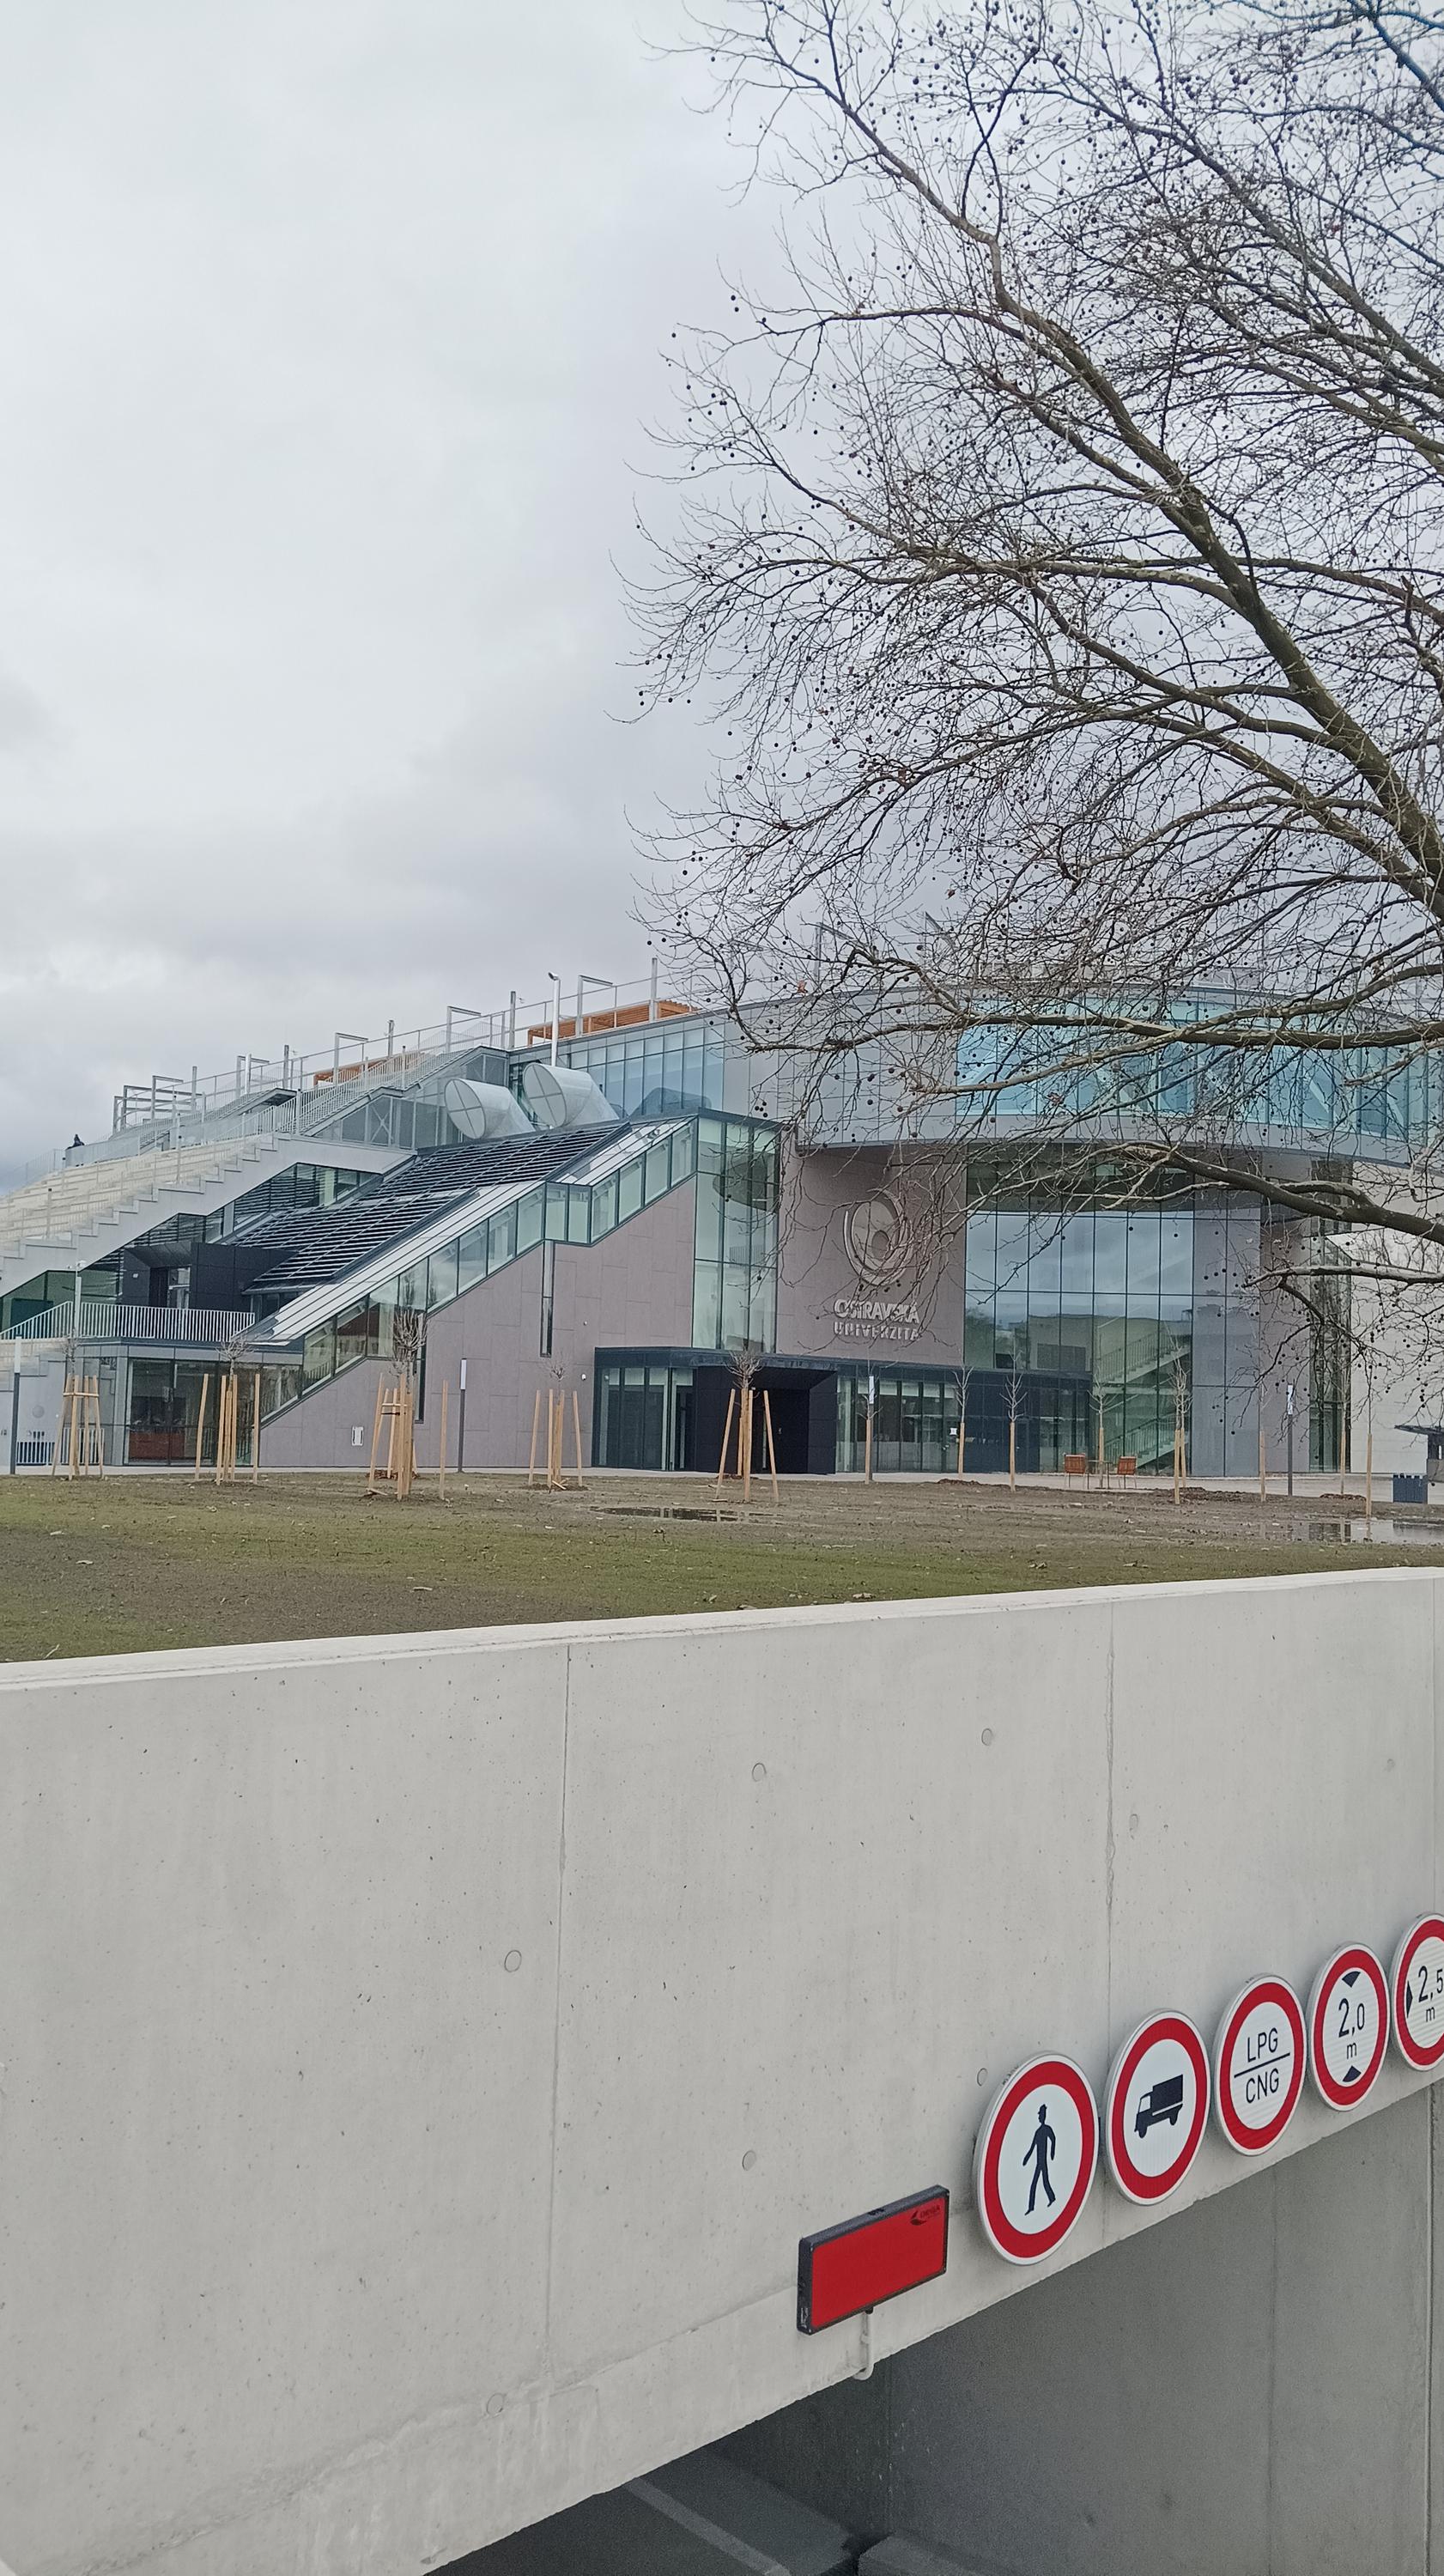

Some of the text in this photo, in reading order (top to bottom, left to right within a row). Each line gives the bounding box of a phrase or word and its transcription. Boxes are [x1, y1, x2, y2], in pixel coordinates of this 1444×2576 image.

[1418, 1965, 1443, 2002] 2,5
[1338, 1998, 1365, 2038] 2,0
[1426, 2007, 1435, 2022] m
[1247, 2027, 1278, 2063] LPG
[1346, 2042, 1357, 2059] m
[1246, 2068, 1279, 2104] CNG
